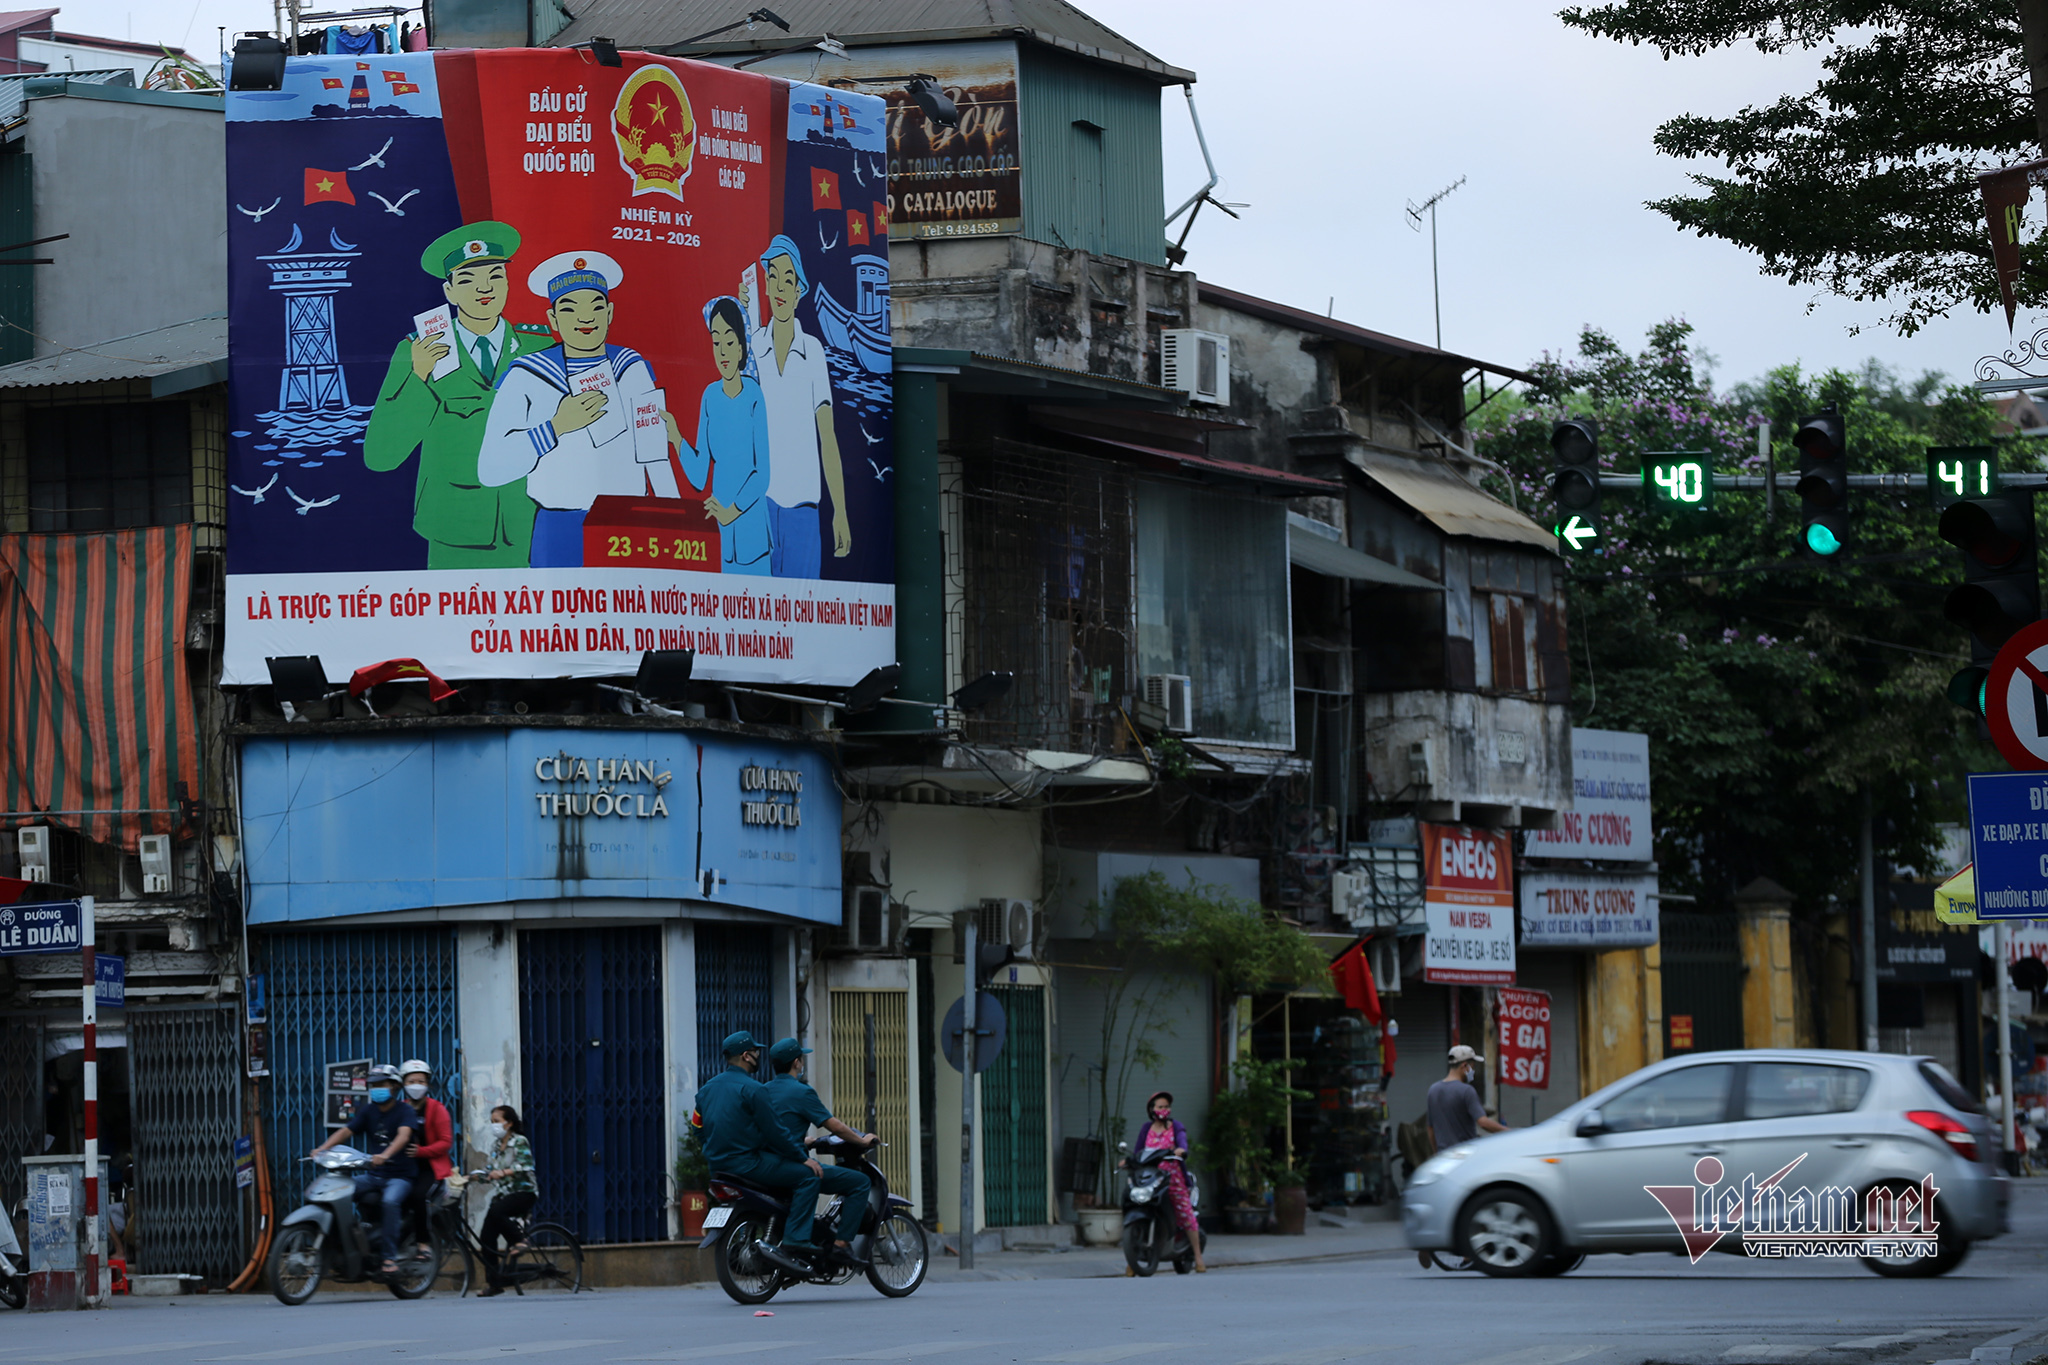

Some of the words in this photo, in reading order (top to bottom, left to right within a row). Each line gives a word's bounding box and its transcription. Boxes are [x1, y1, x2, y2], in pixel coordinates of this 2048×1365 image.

[529, 86, 561, 112] BẦU
[566, 84, 588, 112] CỬ
[526, 123, 553, 146] ĐẠI
[557, 115, 592, 142] BIỂU
[711, 105, 721, 128] VÀ
[721, 110, 733, 134] ĐẠI
[733, 105, 748, 133] BIỂU
[700, 132, 711, 160] HỘI
[712, 131, 730, 159] ĐỒNG
[730, 138, 748, 162] NHÂN
[748, 140, 762, 164] DÂN
[523, 146, 566, 174] QUỐC
[570, 149, 595, 177] HỘI
[907, 156, 953, 181] TRUNG
[958, 154, 985, 178] CAO
[990, 144, 1014, 177] CẤP
[719, 164, 732, 188] CÁC
[733, 164, 746, 190] CẤP
[904, 189, 998, 212] CATALOGUE
[621, 206, 671, 225] NHIỆM
[675, 210, 693, 227] KỲ
[922, 225, 943, 236] Tel:
[946, 223, 999, 236] 9.424552
[612, 226, 653, 242] 2021
[667, 231, 701, 248] 2026
[579, 371, 605, 385] PHIẾU
[637, 402, 656, 416] PHIẾU
[1654, 462, 1702, 502] 40
[1938, 458, 1989, 496] 41
[608, 536, 632, 557] 23
[649, 537, 659, 558] 5
[674, 538, 707, 561] 2021
[247, 591, 272, 620] LÀ
[278, 592, 331, 624] TRỰC
[338, 585, 382, 618] TIẾP
[390, 587, 431, 617] GÓP
[438, 582, 497, 615] PHẦN
[503, 585, 545, 615] XÂY
[552, 587, 607, 619] DỰNG
[613, 584, 647, 614] NHÀ
[650, 584, 687, 615] NƯỚC
[691, 588, 719, 618] PHÁP
[722, 588, 756, 621] QUYỀN
[758, 594, 772, 622] XÃ
[775, 594, 791, 627] HỘI
[794, 590, 814, 623] CHỦ
[817, 597, 847, 626] NGHĨA
[848, 598, 869, 631] VIỆT
[871, 604, 893, 628] NAM
[471, 619, 513, 653] CỦA
[520, 623, 578, 652] NHÂN
[585, 622, 630, 654] DÂN,
[634, 627, 654, 651] DO
[659, 624, 695, 650] NHÂN
[698, 626, 722, 659] DÂN,
[725, 628, 735, 657] VÌ
[738, 629, 766, 658] NHÂN
[769, 631, 793, 660] DÂN!
[536, 785, 632, 818] THUỐC
[742, 795, 786, 825] THUỐC
[1982, 825, 1997, 842] XE
[1999, 824, 2024, 845] ĐẠP,
[2024, 823, 2039, 840] XE
[1440, 837, 1497, 880] ENEOS
[1547, 889, 1589, 914] TRUNG
[1984, 885, 2030, 909] NHƯỜNG
[24, 908, 61, 921] ĐƯỜNG
[1449, 910, 1467, 928] NAM
[1468, 912, 1492, 929] VESPA
[1, 926, 21, 947] LÊ
[27, 920, 77, 945] DUẨN
[1463, 940, 1473, 960] XE
[1475, 941, 1485, 961] GA
[1490, 941, 1499, 961] XE
[1501, 935, 1512, 961] SỐ
[1517, 1024, 1547, 1050] GA
[1513, 1051, 1546, 1083] SỐ
